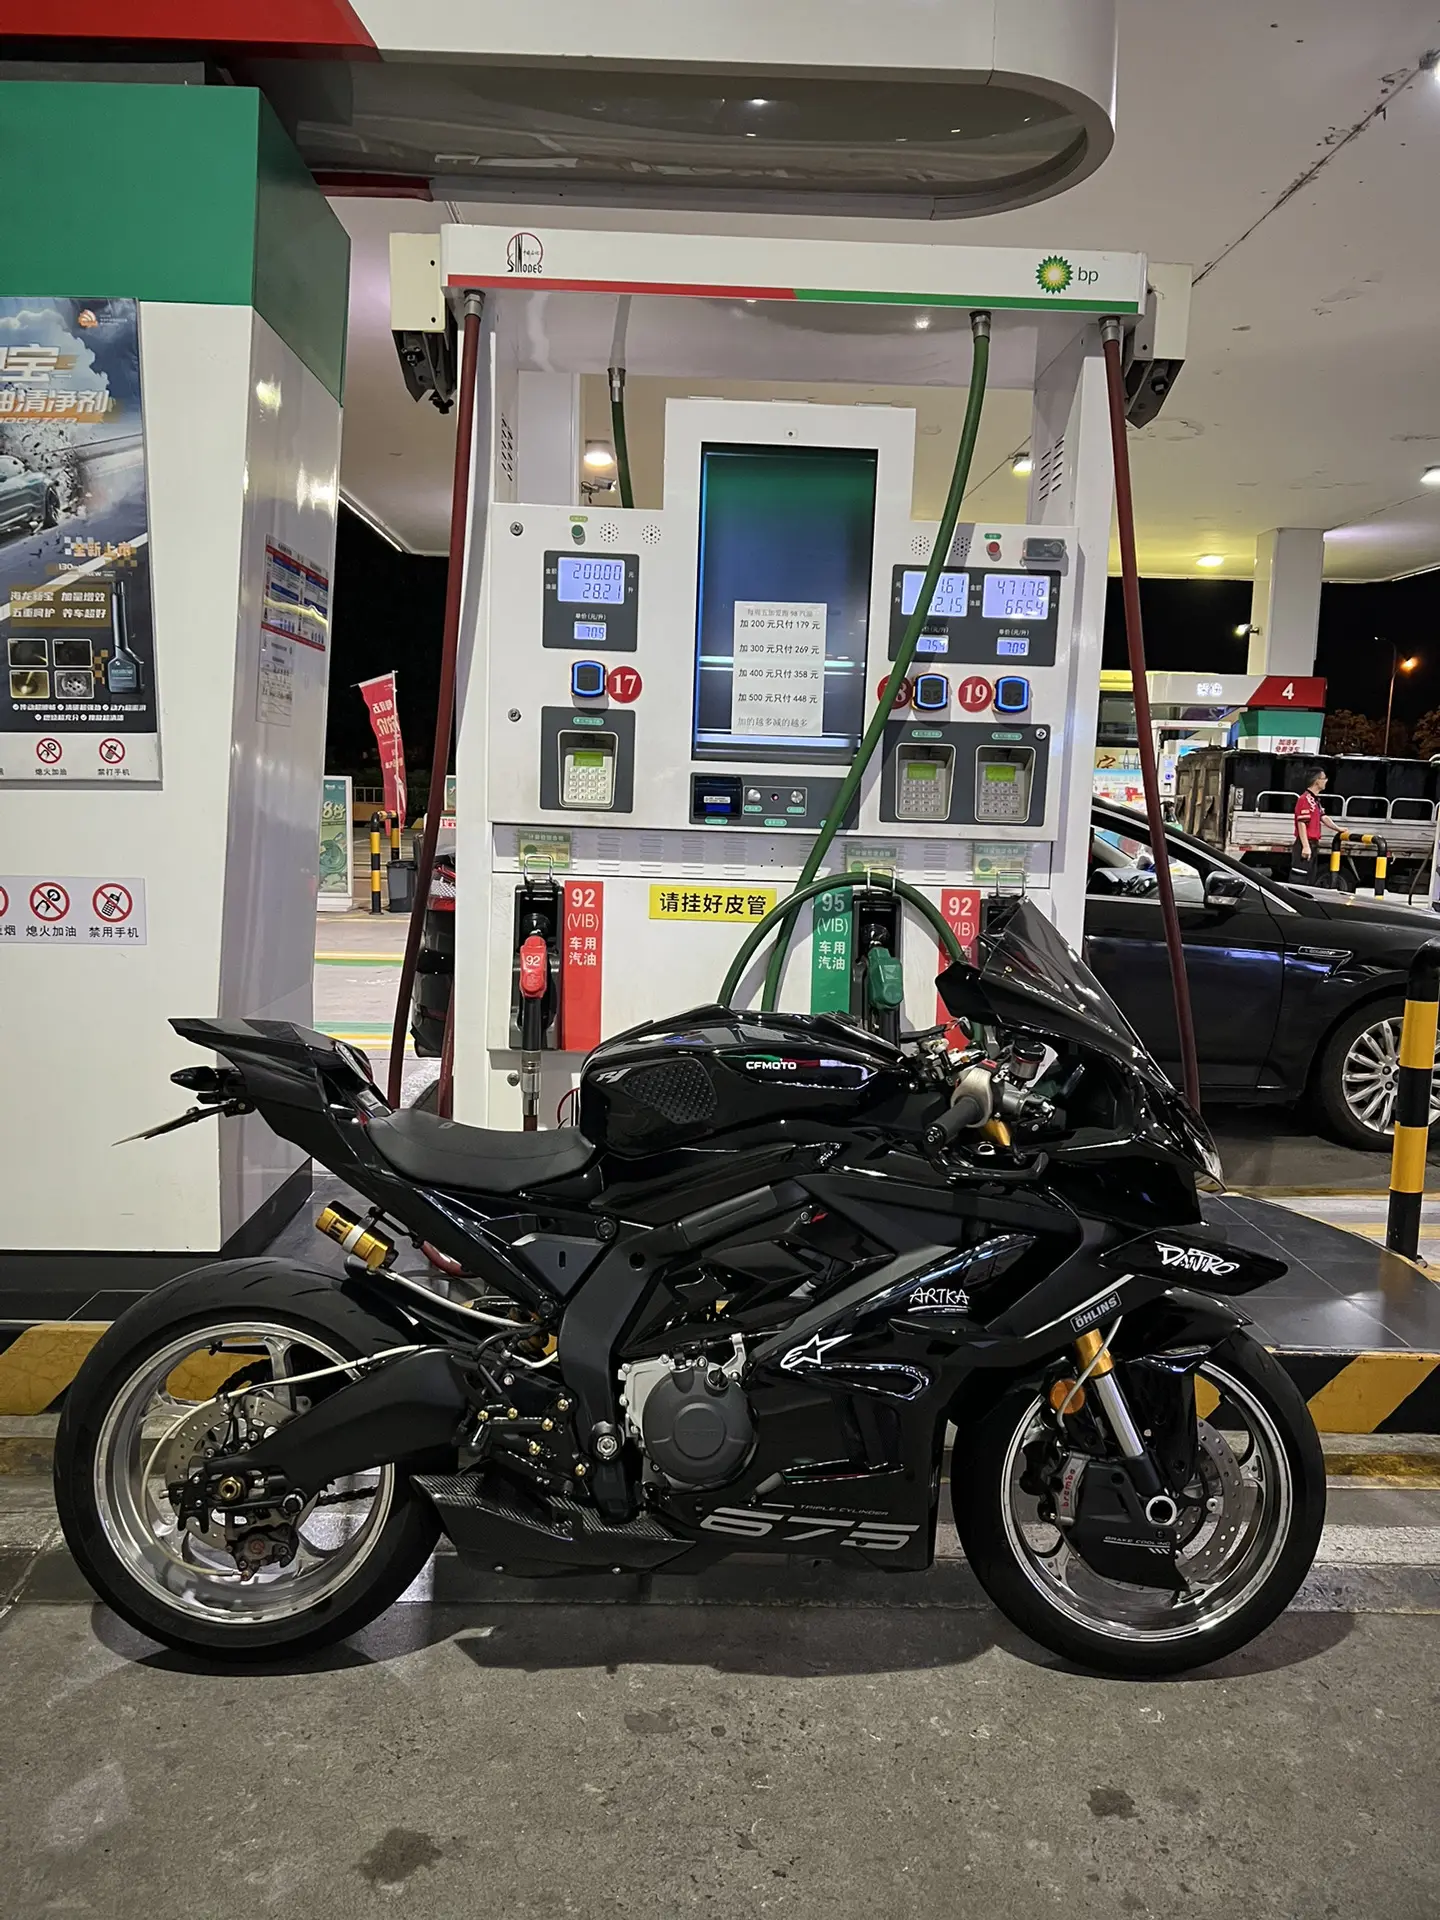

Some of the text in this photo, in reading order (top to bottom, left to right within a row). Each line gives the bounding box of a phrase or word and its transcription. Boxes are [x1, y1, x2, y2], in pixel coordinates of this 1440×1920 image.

[1078, 267, 1099, 284] bp
[0, 343, 60, 381] 宝
[573, 563, 622, 580] 200.00
[583, 583, 622, 599] 28.21
[940, 578, 965, 593] 1.61
[997, 580, 1045, 597] 471.76
[739, 619, 749, 628] 加
[751, 620, 765, 628] 200
[767, 620, 793, 629] 元只付
[812, 621, 821, 630] 元
[739, 644, 748, 652] 加
[766, 644, 793, 654] 元只付
[795, 645, 809, 653] 269
[811, 645, 819, 654] 元
[738, 669, 819, 679] 加 400 元只付 358 元
[614, 674, 637, 695] 17
[1281, 682, 1295, 700] 4
[738, 693, 818, 703] 加 500 元只付 448 元
[964, 684, 988, 704] 19
[35, 768, 67, 776] 熄火加油
[98, 768, 130, 776] 禁打手机
[571, 888, 596, 908] 92
[660, 892, 767, 915] 请挂好皮管
[822, 892, 845, 912] 95
[948, 897, 972, 916] 92
[567, 912, 599, 931] (VIB)
[816, 918, 849, 935] (VIB)
[25, 925, 77, 937] 熄火加油
[89, 926, 139, 938] 禁用手机
[949, 922, 976, 940] VIB)
[568, 936, 597, 950] 车用
[818, 940, 846, 955] 车用
[526, 955, 541, 966] 92
[568, 952, 597, 966] 汽油
[818, 956, 846, 971] 汽油
[746, 1060, 797, 1070] CFMOTO
[909, 1286, 970, 1305] ARTKA
[1075, 1297, 1118, 1329] ÖHLINS
[1062, 1468, 1076, 1508] brembo
[800, 1504, 889, 1517] TRIPLE CYLINDER
[700, 1507, 920, 1550] 675
[1104, 1535, 1133, 1543] BRAKE
